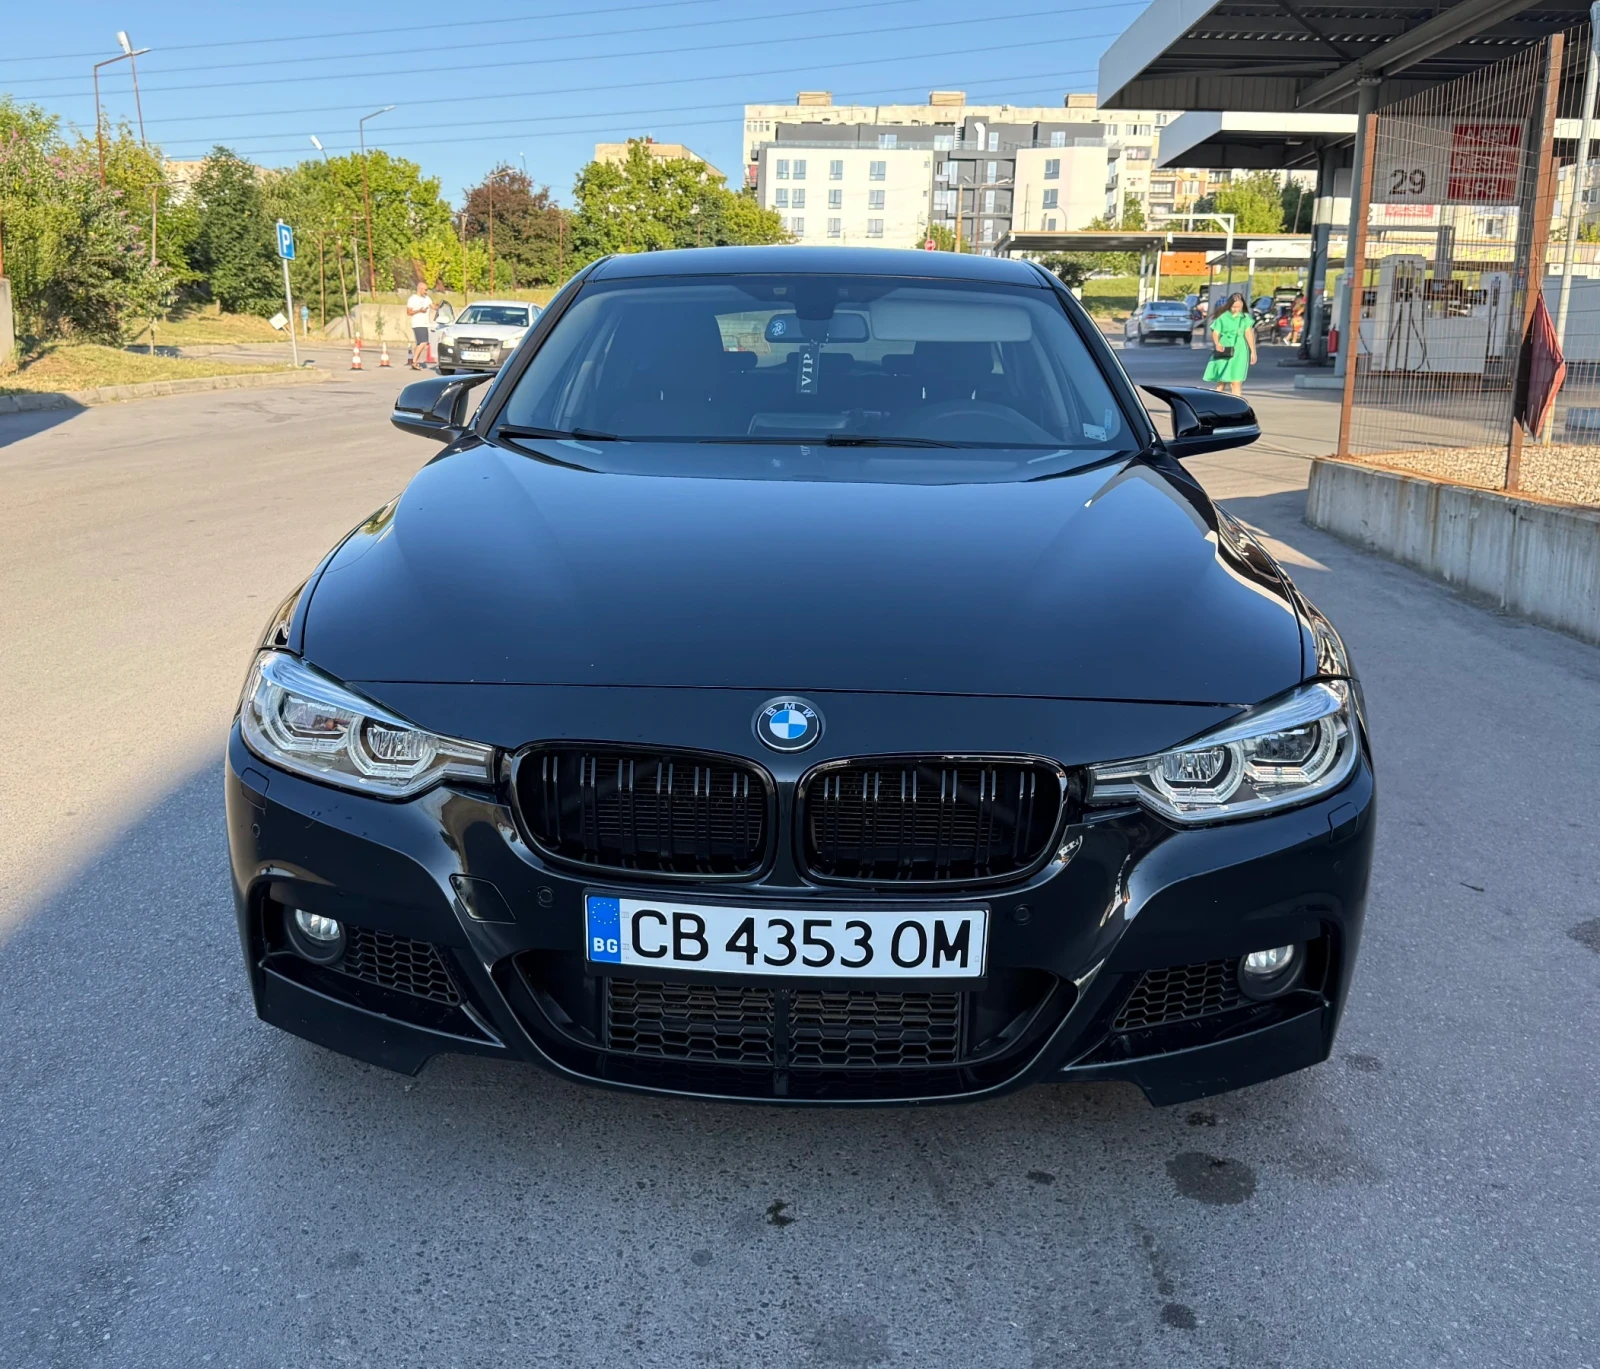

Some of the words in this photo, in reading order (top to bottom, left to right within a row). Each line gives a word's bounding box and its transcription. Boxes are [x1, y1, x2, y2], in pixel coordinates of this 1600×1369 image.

[1455, 154, 1512, 170] DIESEL
[1389, 169, 1426, 195] 29
[1464, 182, 1497, 195] LPG
[281, 228, 291, 254] P
[801, 353, 814, 387] VIP
[765, 702, 815, 719] BMW
[592, 936, 619, 954] BG
[631, 909, 709, 962] CB
[725, 917, 874, 968] 4353
[890, 919, 971, 969] OM
